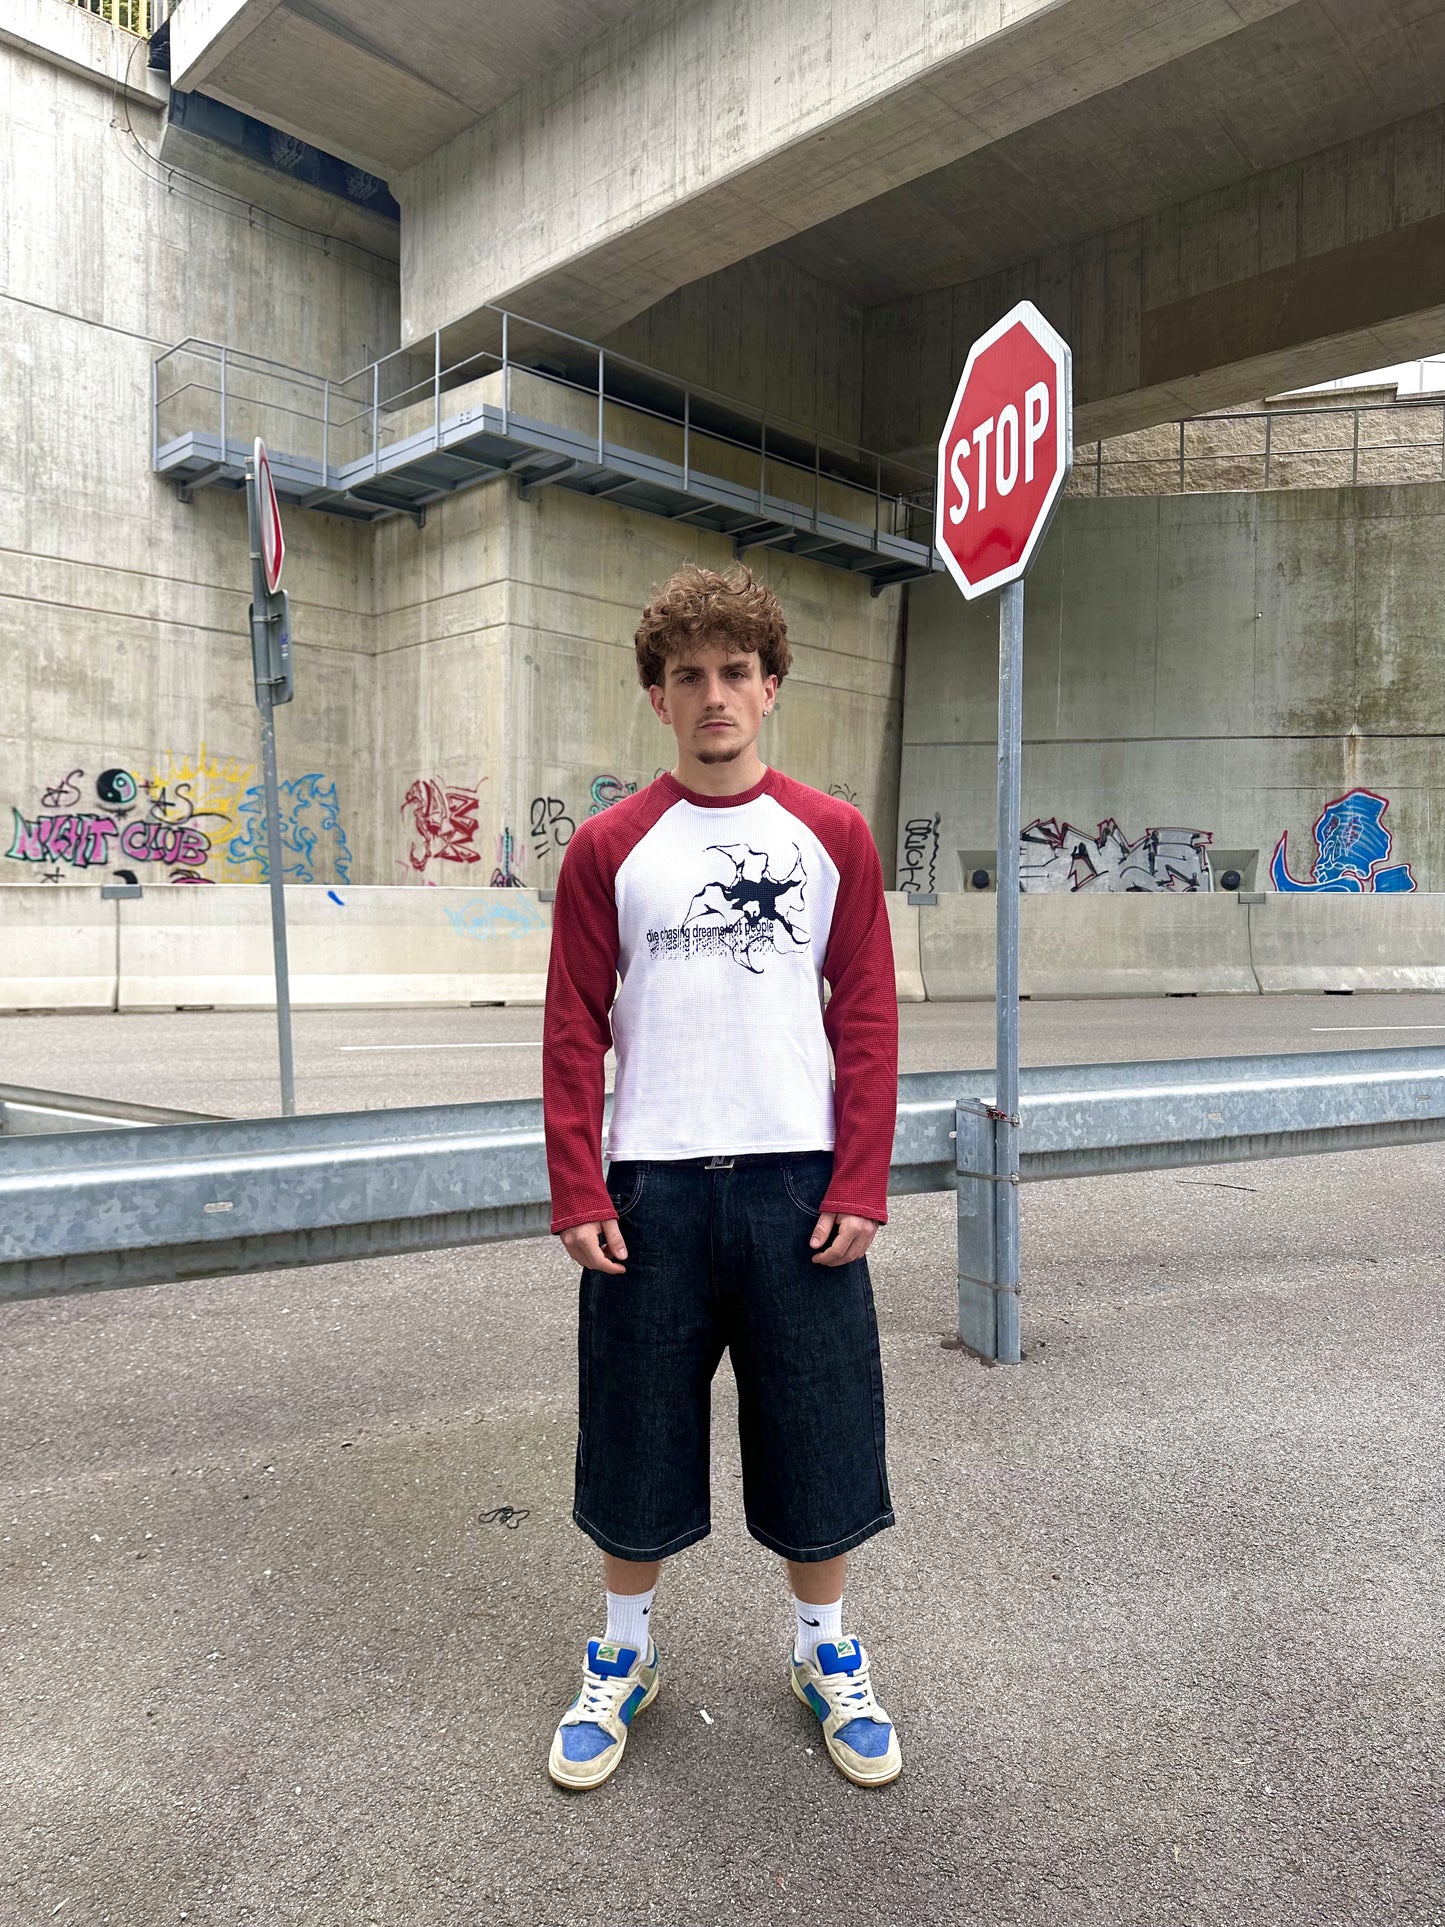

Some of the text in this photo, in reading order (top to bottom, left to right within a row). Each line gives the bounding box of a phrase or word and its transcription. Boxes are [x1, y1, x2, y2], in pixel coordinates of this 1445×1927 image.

[949, 381, 1050, 525] STOP
[121, 819, 212, 867] CLUB
[646, 928, 660, 943] die
[660, 924, 691, 943] chasing
[744, 919, 774, 937] people
